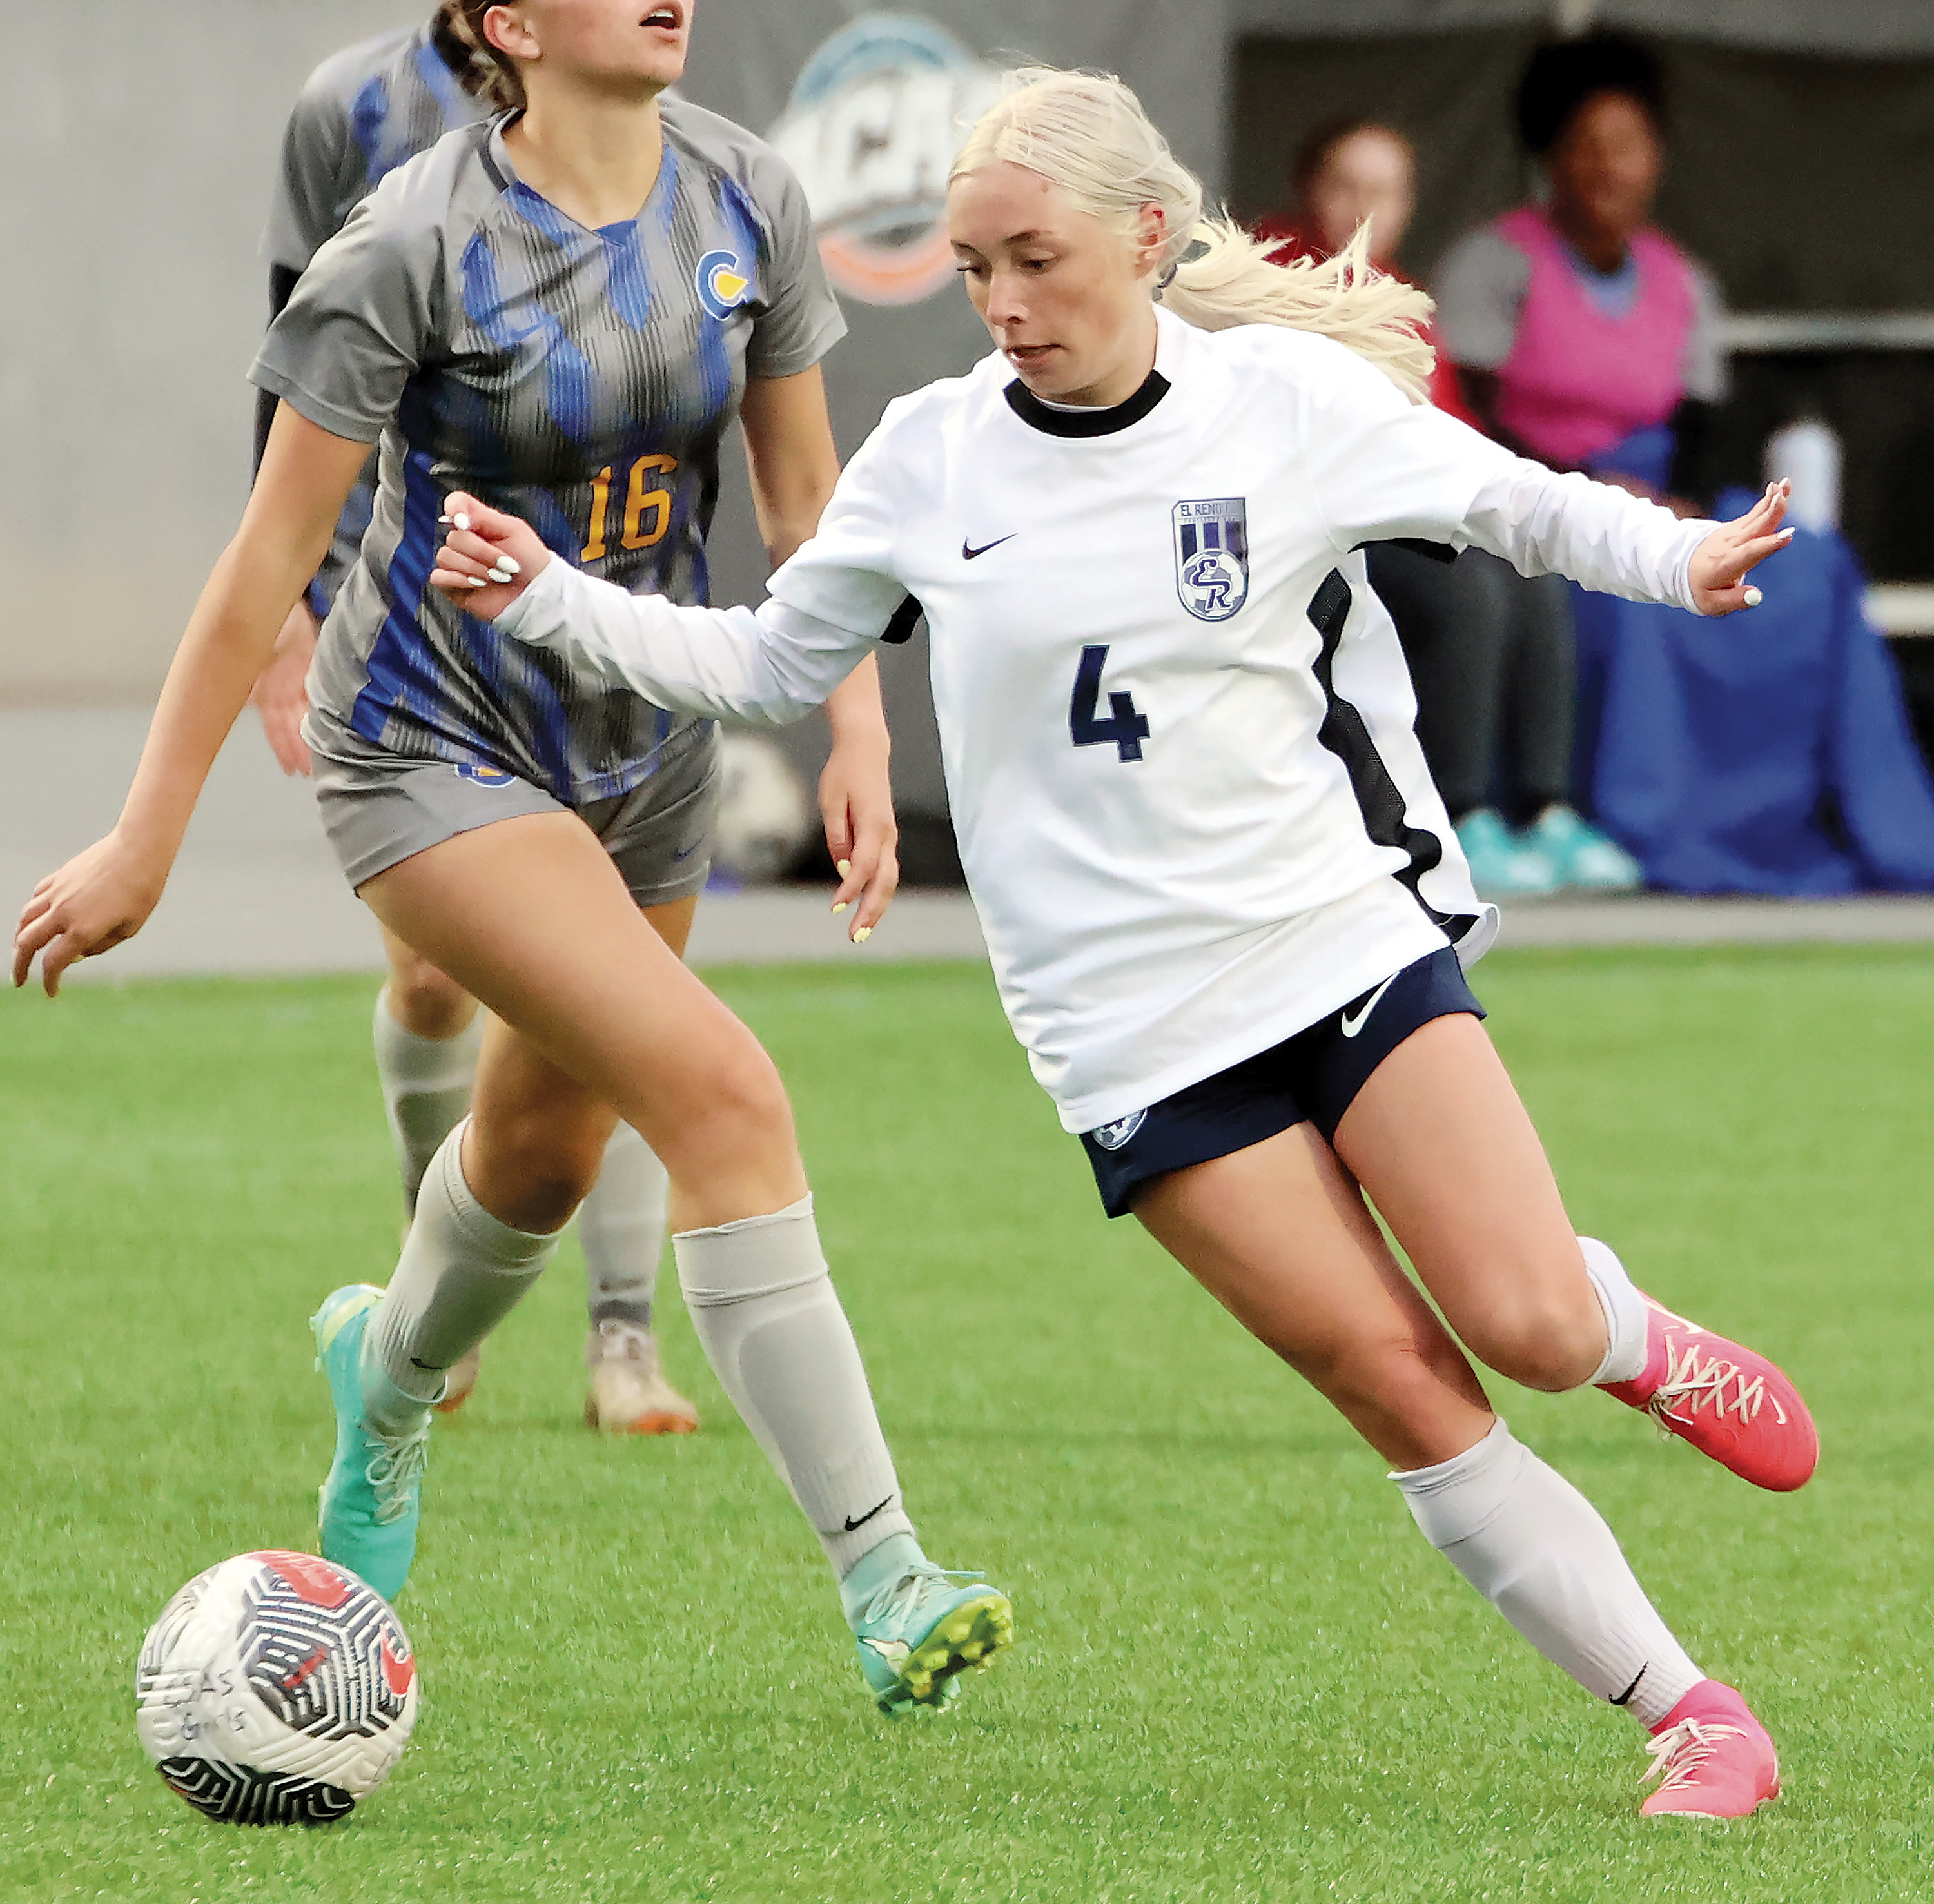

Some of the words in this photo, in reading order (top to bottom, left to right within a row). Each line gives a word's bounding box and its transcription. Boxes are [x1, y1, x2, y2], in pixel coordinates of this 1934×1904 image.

[581, 453, 678, 562] 16
[1180, 505, 1191, 516] EL
[1069, 645, 1150, 763] 4
